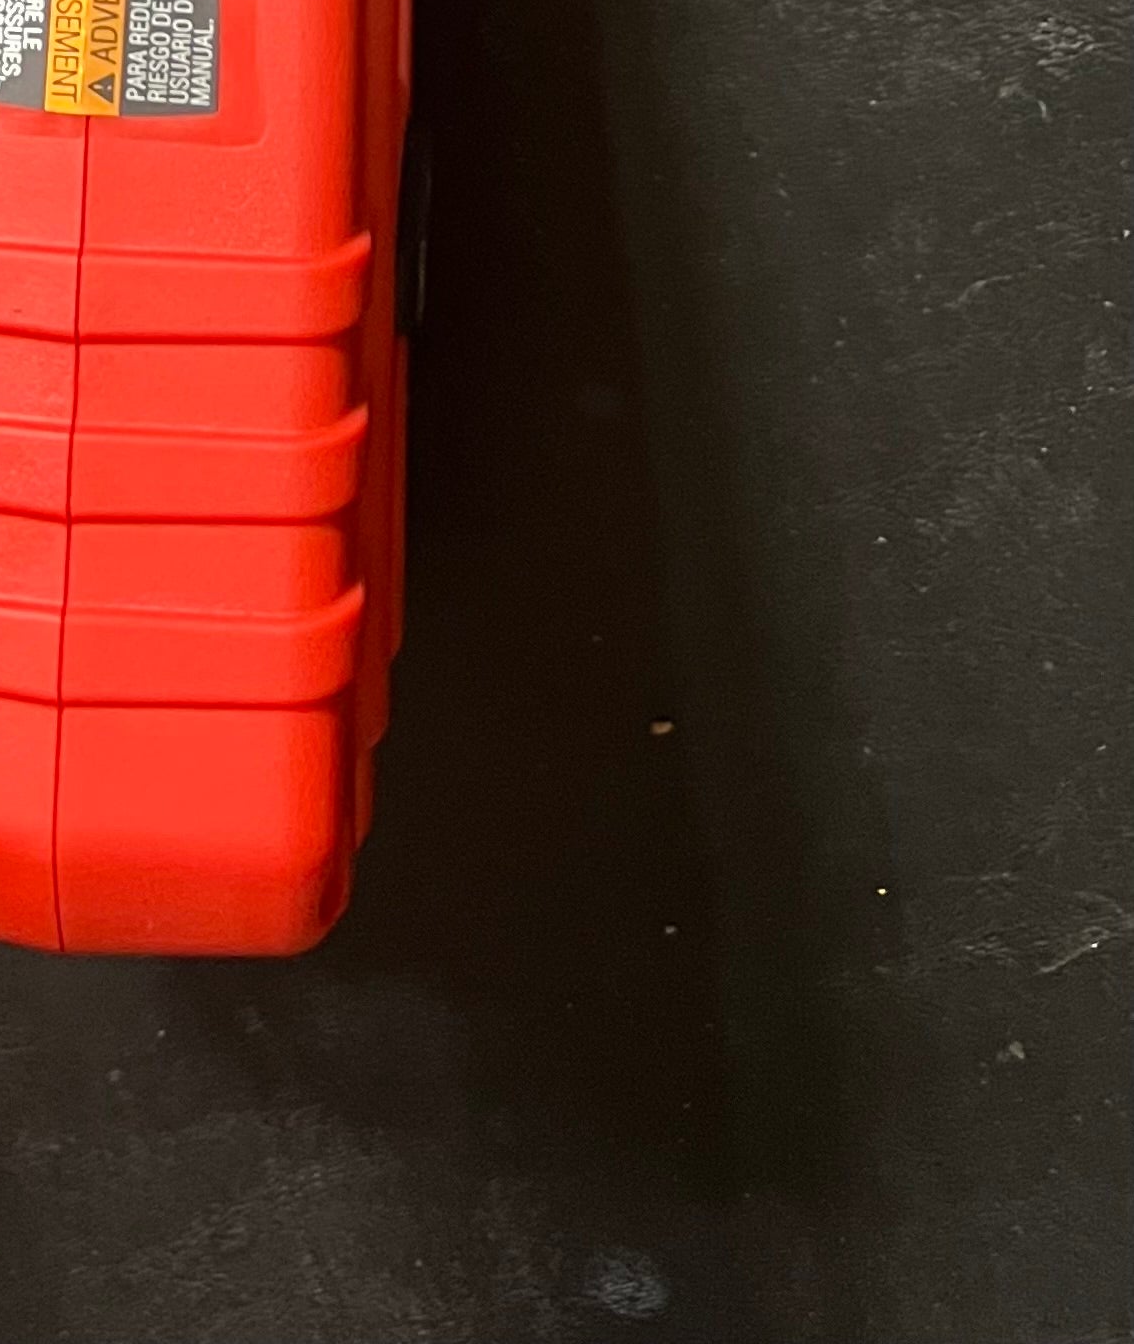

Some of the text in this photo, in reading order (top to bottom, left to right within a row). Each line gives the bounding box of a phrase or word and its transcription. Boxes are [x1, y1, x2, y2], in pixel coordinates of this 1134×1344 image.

[25, 27, 42, 50] LE
[154, 2, 172, 24] DE
[127, 50, 148, 101] PARA
[149, 32, 171, 103] RIESGO
[170, 19, 193, 104] USUARIO
[191, 19, 214, 106] MANUAL.
